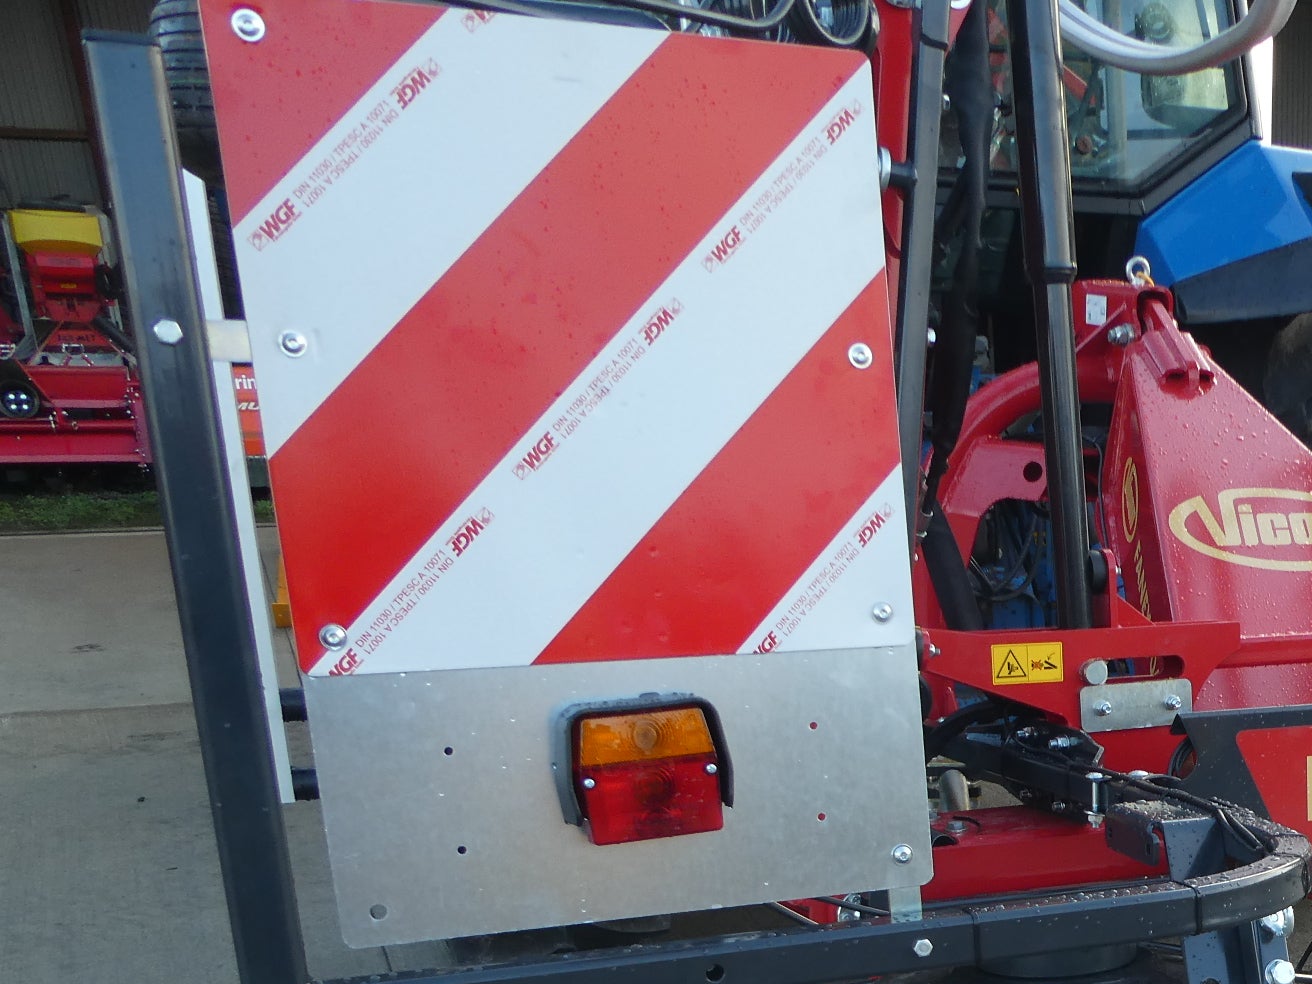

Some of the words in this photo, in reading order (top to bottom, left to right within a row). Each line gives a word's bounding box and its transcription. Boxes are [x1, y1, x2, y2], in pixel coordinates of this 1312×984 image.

[397, 70, 431, 108] WGF
[382, 109, 398, 126] DIN
[827, 110, 855, 144] WGF
[260, 199, 296, 237] WGF
[293, 181, 310, 199] DIN
[712, 226, 741, 261] WGF
[644, 309, 674, 344] WGF
[523, 432, 554, 468] WGF
[450, 519, 484, 556] WGF
[859, 514, 886, 547] WGF
[438, 557, 454, 573] DIN
[355, 631, 372, 647] DIN
[370, 609, 392, 631] 11030
[424, 550, 445, 572] 10071
[418, 573, 439, 595] 11030
[364, 633, 386, 654] 10071
